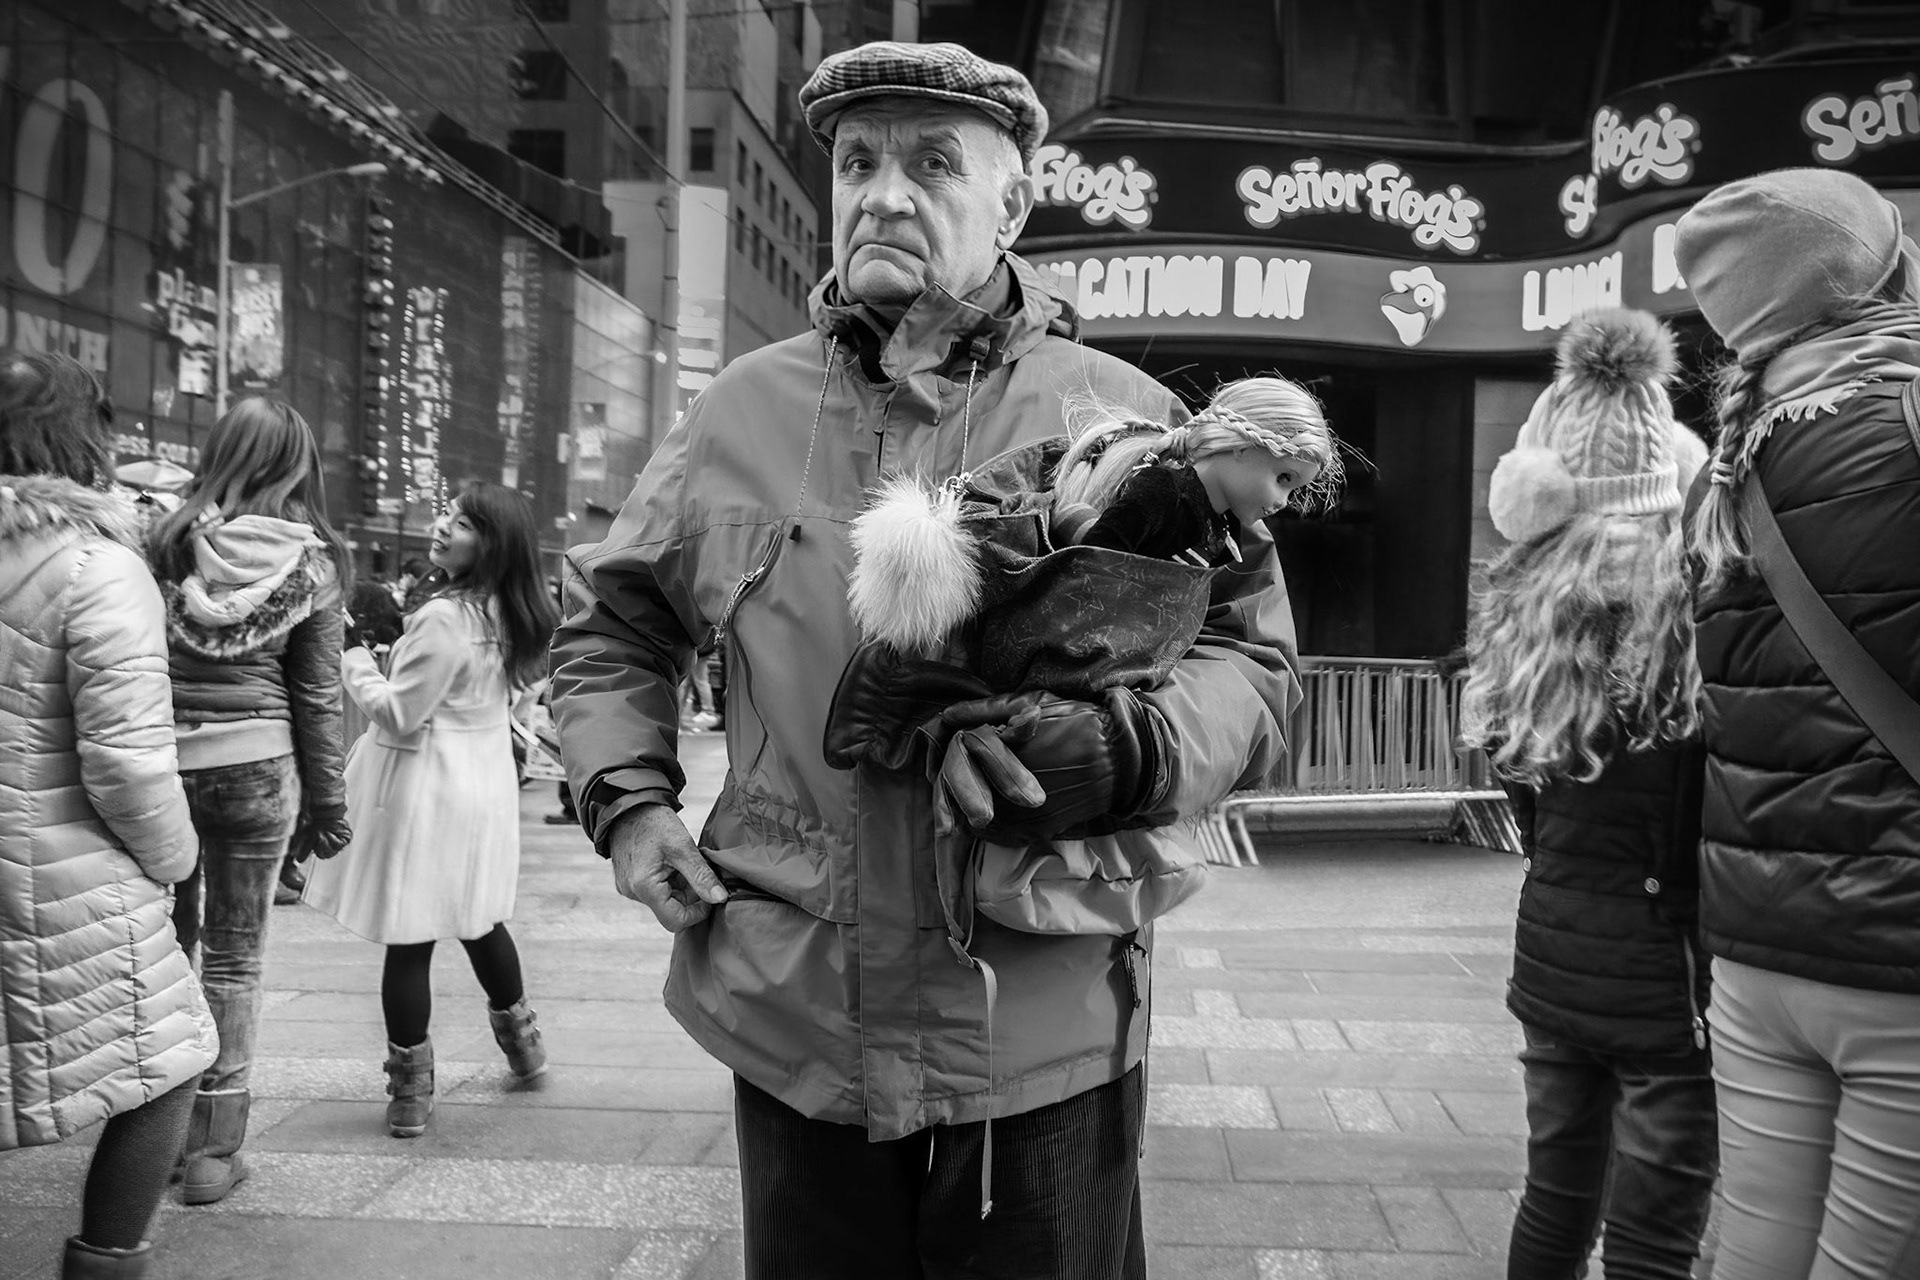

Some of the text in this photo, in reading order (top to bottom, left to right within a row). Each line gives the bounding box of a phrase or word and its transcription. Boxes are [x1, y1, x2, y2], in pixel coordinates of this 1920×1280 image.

[1806, 79, 1920, 161] Señ
[1030, 144, 1154, 224] Frog's
[1240, 160, 1366, 223] Señor
[1365, 161, 1480, 251] Frog's
[1233, 255, 1312, 320] DAY
